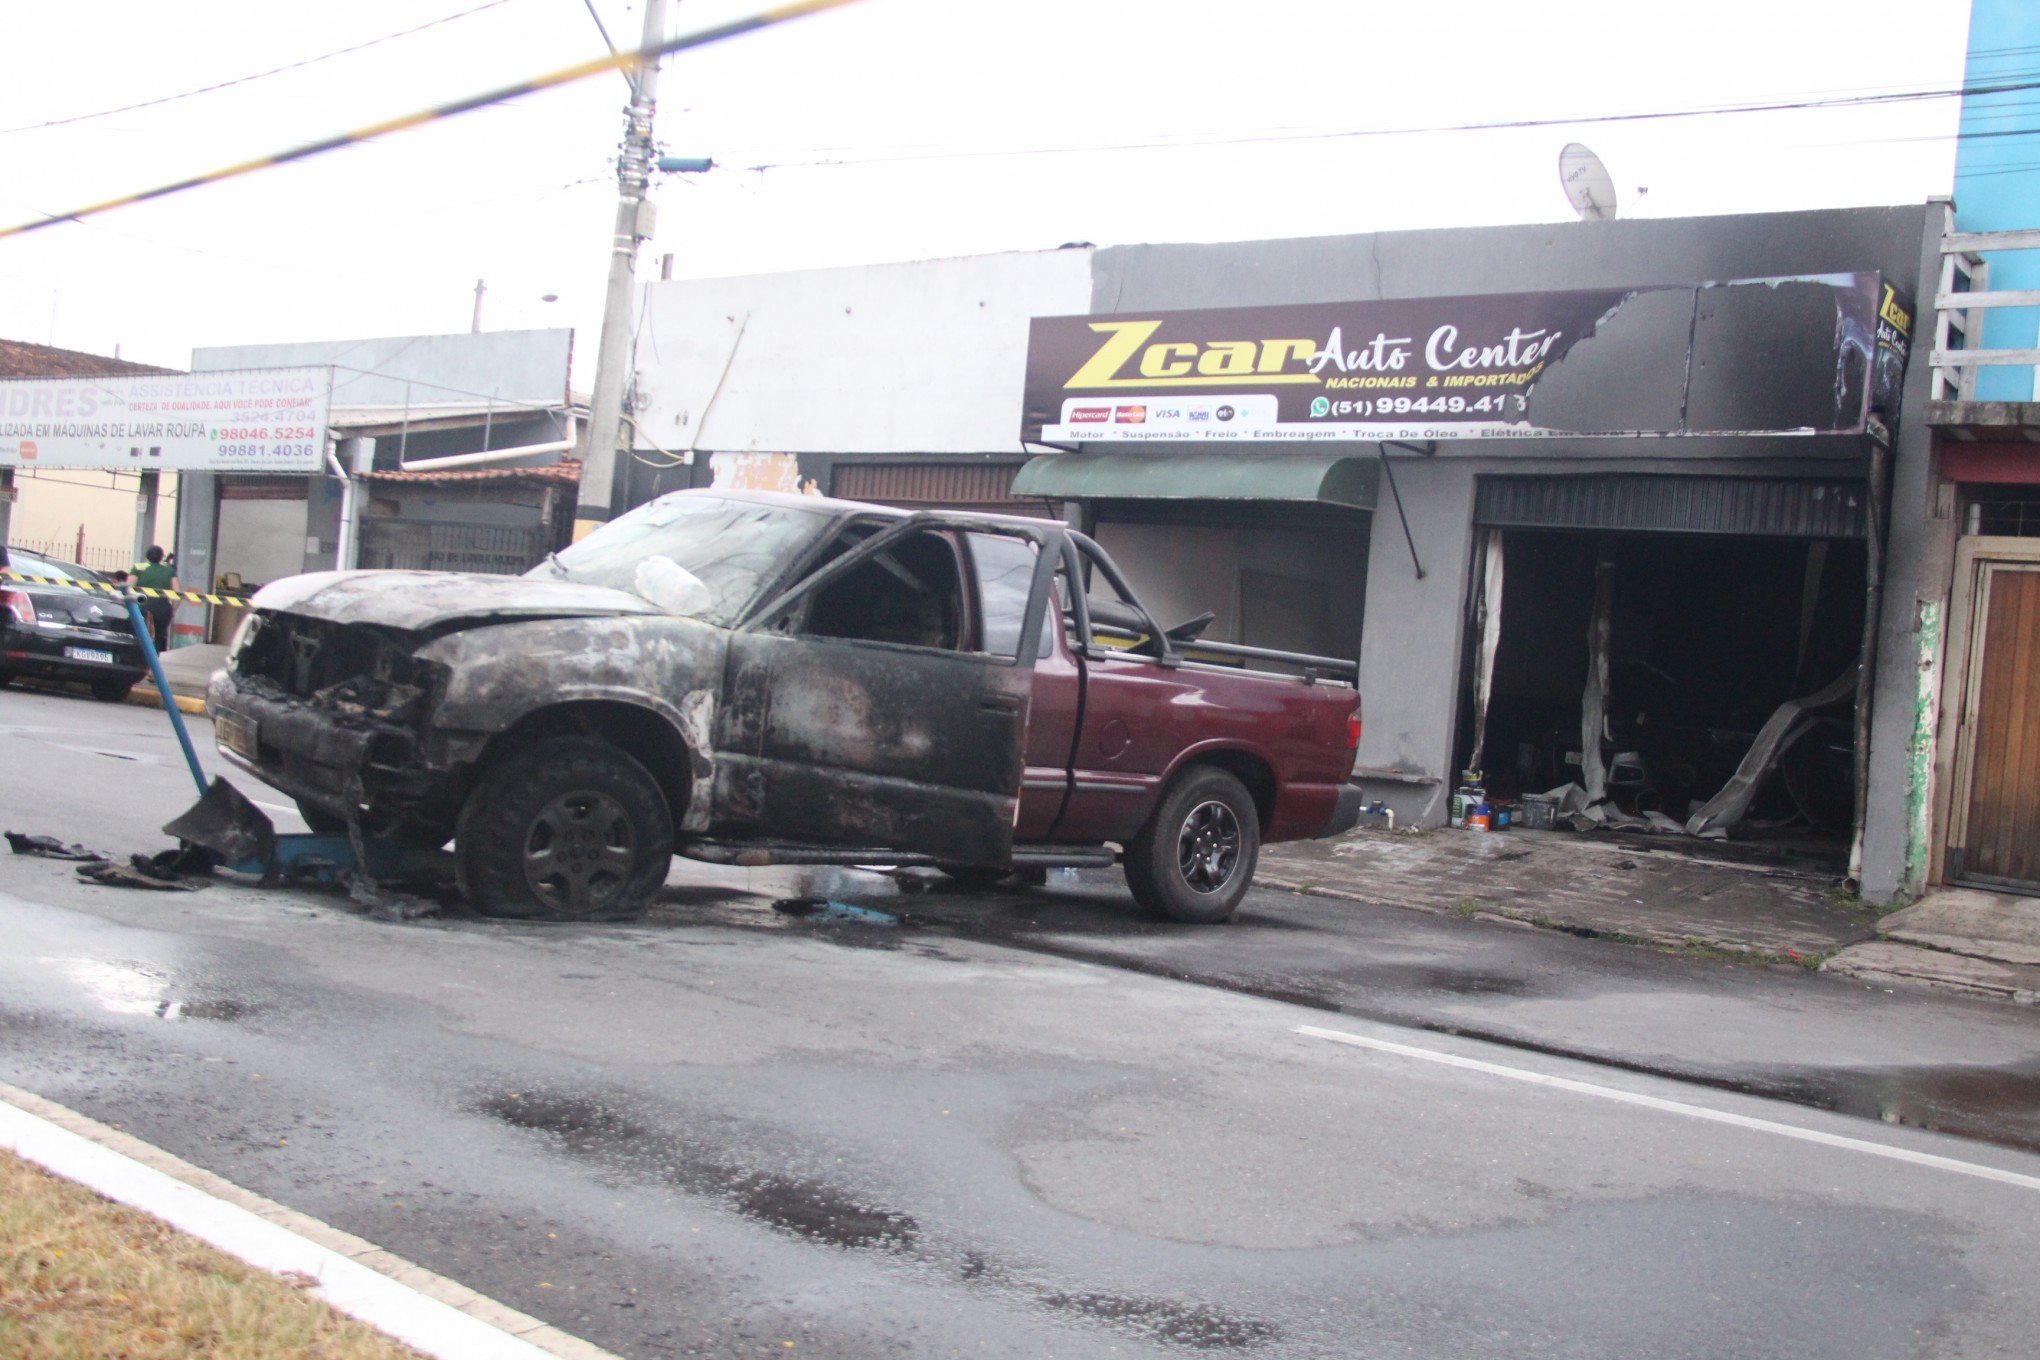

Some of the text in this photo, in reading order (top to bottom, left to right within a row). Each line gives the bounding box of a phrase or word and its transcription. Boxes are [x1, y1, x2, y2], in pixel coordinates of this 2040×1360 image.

[1063, 320, 1321, 388] Zcar
[1306, 325, 1562, 373] Auto Center
[1325, 376, 1417, 389] NACIONAIS
[1426, 376, 1439, 388] &
[254, 399, 273, 409] PODE
[1331, 400, 1373, 416] (51)
[1072, 409, 1109, 421] Hipercard
[1155, 409, 1181, 418] VISA
[36, 424, 51, 438] EM
[53, 420, 108, 438] MÁQUINAS
[111, 424, 126, 438] DE
[129, 423, 164, 438] LAVAR
[167, 422, 206, 438] ROUPA
[219, 427, 315, 440] 98046.5254
[1069, 430, 1105, 438] Motor
[1121, 429, 1190, 440] Suspensão
[1205, 429, 1238, 438] Freio
[1253, 429, 1336, 440] Embreagem
[1353, 429, 1394, 438] Troca
[1400, 430, 1416, 438] De
[1424, 427, 1458, 438] Óleo
[218, 444, 314, 457] 99881.4036
